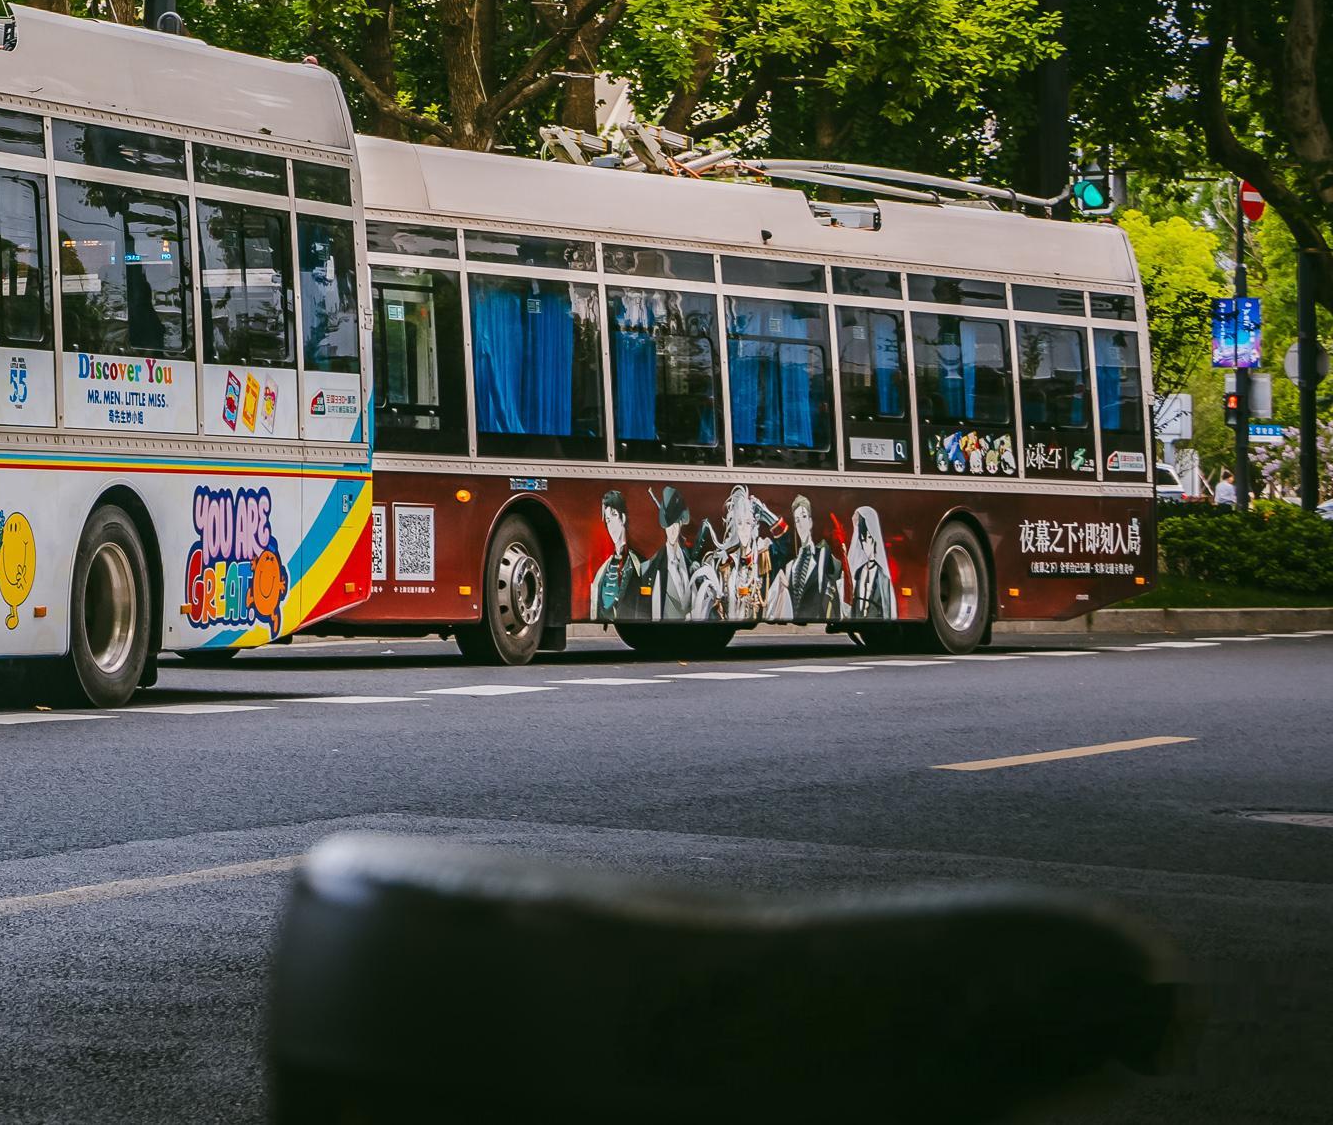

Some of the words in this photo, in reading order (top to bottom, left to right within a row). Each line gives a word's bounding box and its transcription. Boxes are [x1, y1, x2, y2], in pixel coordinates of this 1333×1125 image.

[9, 369, 28, 403] 55
[78, 353, 142, 382] Discover
[145, 358, 173, 385] You
[87, 389, 102, 404] MR.
[125, 391, 146, 407] LITTLE
[194, 492, 233, 565] YOU
[235, 493, 270, 561] ARE
[187, 549, 255, 624] GREAT.
